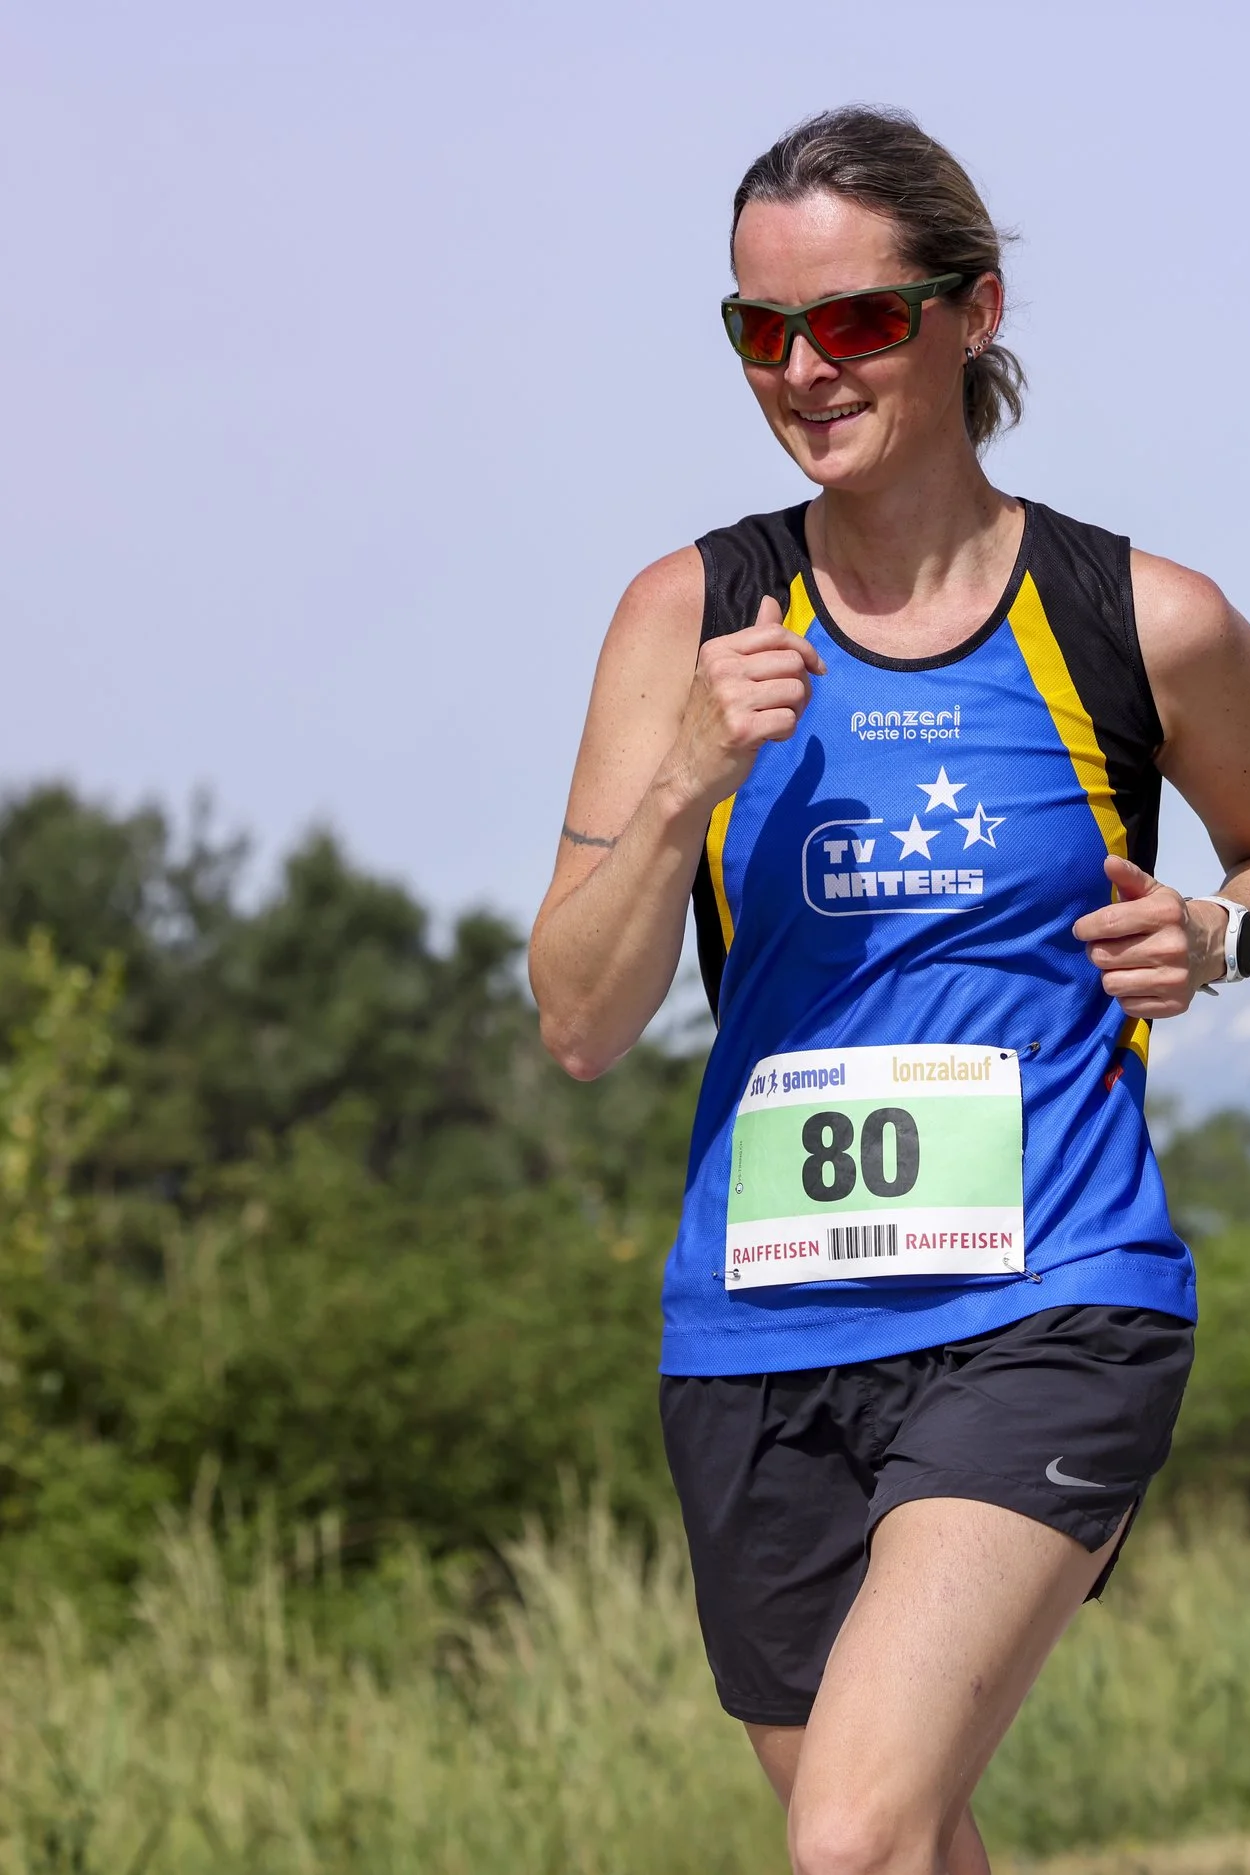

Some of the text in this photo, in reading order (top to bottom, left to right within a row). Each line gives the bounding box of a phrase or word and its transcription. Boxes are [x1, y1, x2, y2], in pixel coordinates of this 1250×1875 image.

[851, 704, 961, 732] panzeri
[858, 727, 961, 743] veste lo sport
[823, 839, 876, 864] TV
[823, 869, 984, 899] NATERS
[750, 1063, 846, 1097] stv gampel
[892, 1055, 992, 1082] lonzalauf
[802, 1107, 920, 1202] 80
[733, 1240, 820, 1264] RAIFFEISEN
[906, 1232, 1013, 1249] RAIFFEISEN
